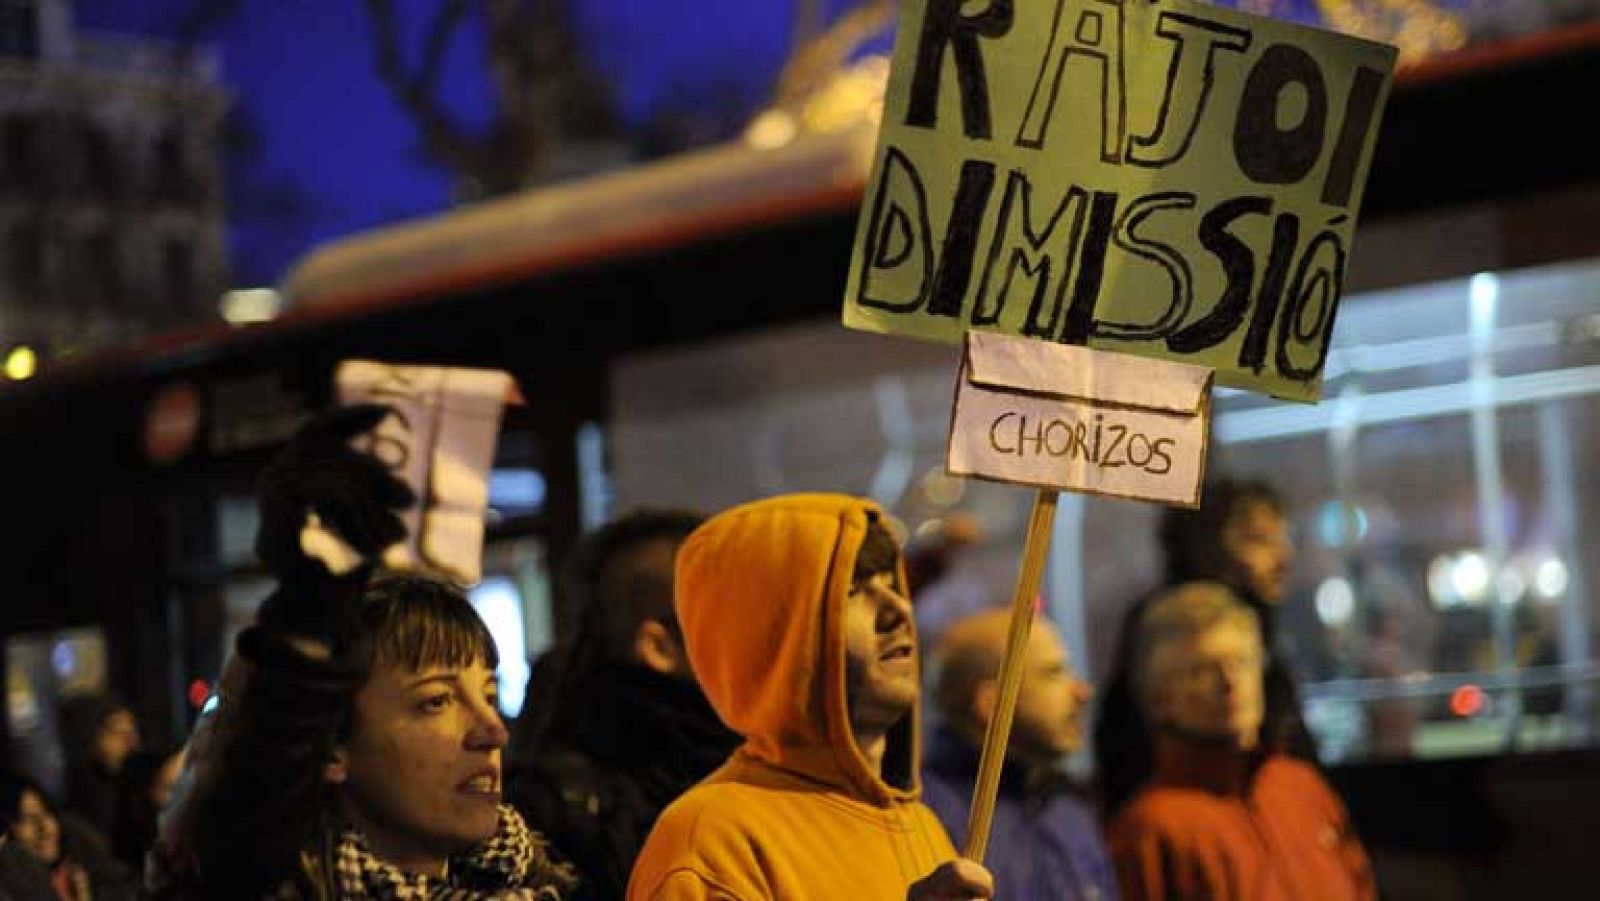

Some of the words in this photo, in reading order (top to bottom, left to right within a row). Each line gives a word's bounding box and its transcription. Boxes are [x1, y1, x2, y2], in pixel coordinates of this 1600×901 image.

[904, 0, 1384, 206] RAJOI
[857, 146, 1347, 380] DIMISSIÓ
[989, 411, 1176, 474] CHORIZOS
